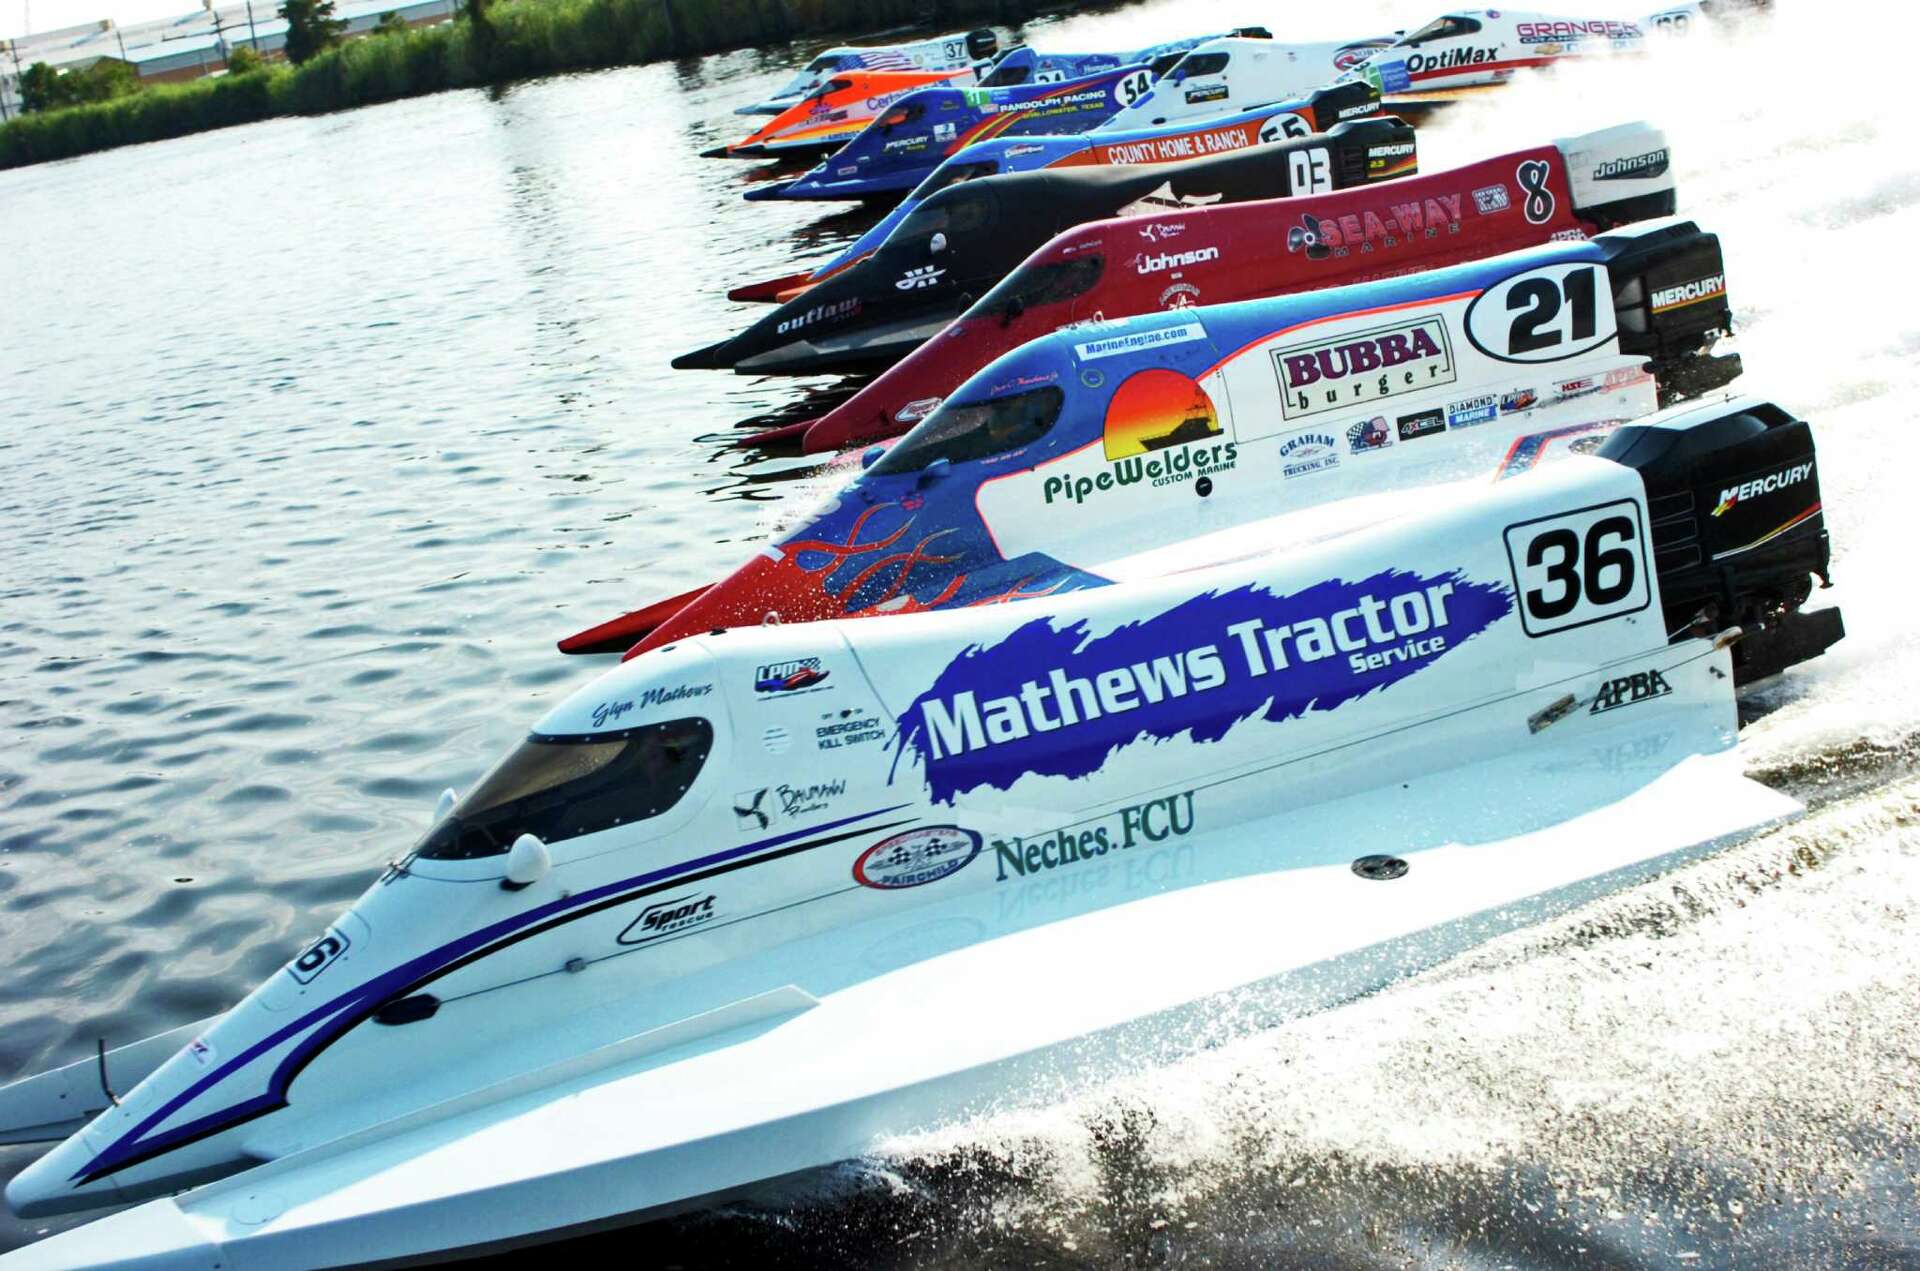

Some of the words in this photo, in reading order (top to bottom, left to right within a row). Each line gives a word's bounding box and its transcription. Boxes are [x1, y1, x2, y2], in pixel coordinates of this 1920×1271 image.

[946, 42, 963, 58] 37
[1406, 47, 1499, 73] OptiMax
[1000, 97, 1061, 113] RANDOLPH
[1063, 89, 1107, 104] RACING
[1123, 71, 1149, 105] 54
[1338, 102, 1380, 119] MERCURY
[1108, 144, 1156, 165] COUNTY
[1158, 137, 1195, 157] HOME
[1196, 135, 1206, 151] &
[1206, 129, 1249, 150] RANCH
[1368, 144, 1415, 158] MERCURY
[1594, 149, 1666, 179] Johnson
[1288, 147, 1333, 197] 03
[1516, 160, 1556, 225] 8
[1318, 193, 1462, 247] SEA-WAY
[1334, 222, 1460, 258] MARINE
[1138, 246, 1219, 275] Johnson
[1651, 274, 1726, 309] MERCURY
[1506, 266, 1596, 356] 21
[1085, 326, 1189, 354] MarineEngine.com
[1284, 327, 1442, 388] BUBBA
[1298, 363, 1438, 410] burger
[1279, 434, 1336, 457] GRAHAM
[1044, 442, 1238, 504] PipeWelders
[1152, 471, 1193, 488] CUSTOM
[1197, 461, 1237, 478] MARINE
[1719, 462, 1813, 505] MERCURY
[1527, 515, 1636, 621] 36
[921, 645, 1227, 761] Mathews
[1226, 581, 1455, 677] Tractor
[1352, 634, 1446, 675] Service
[1590, 669, 1672, 712] APBA
[816, 717, 880, 738] EMERGENCY
[818, 738, 842, 750] KILL
[844, 729, 886, 745] SWITCH
[882, 861, 959, 885] FAIRCHILD
[641, 895, 716, 931] Sport
[661, 911, 713, 932] rescue
